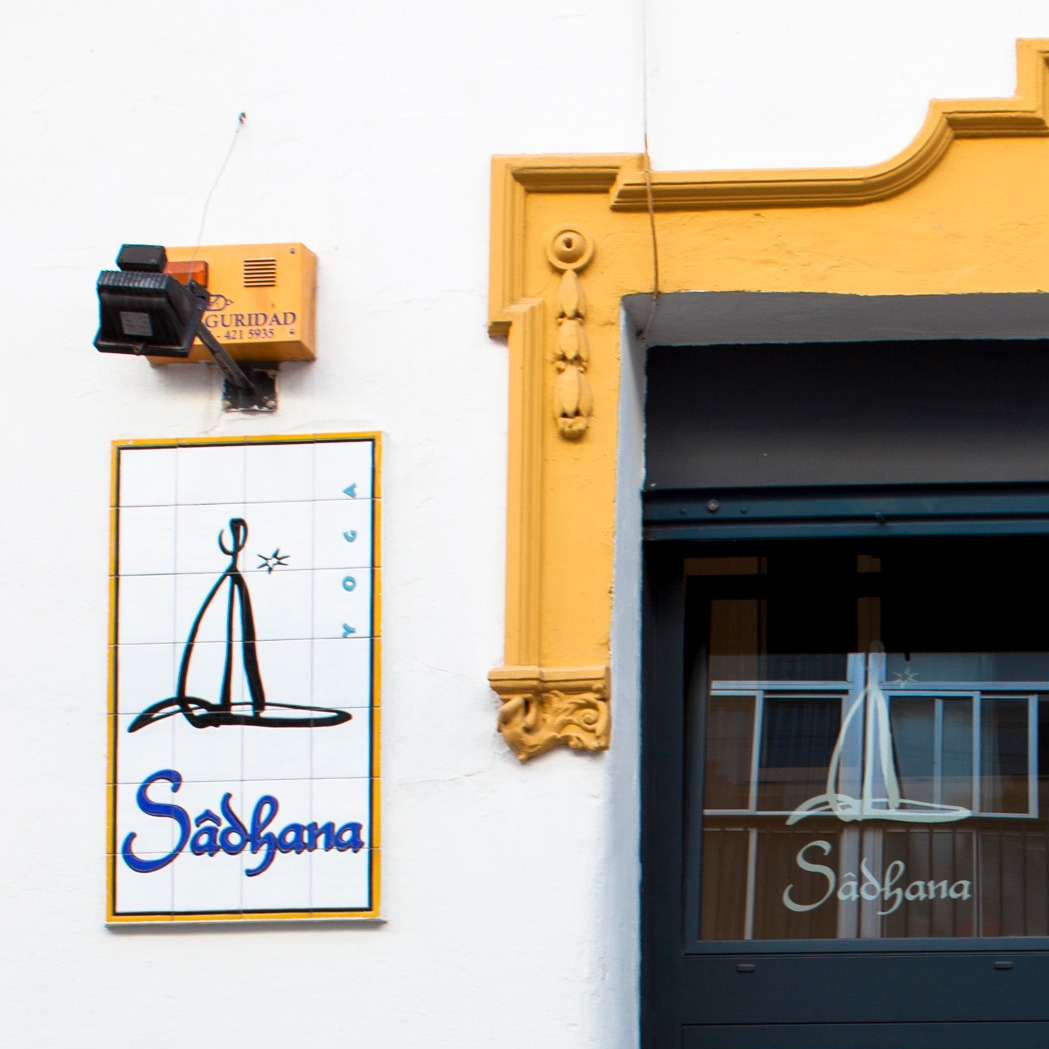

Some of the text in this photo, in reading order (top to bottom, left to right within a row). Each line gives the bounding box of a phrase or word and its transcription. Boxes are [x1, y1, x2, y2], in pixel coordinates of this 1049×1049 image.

[204, 311, 297, 329] GURIDAD
[224, 328, 275, 340] 421 5935
[121, 768, 366, 877] Sâdhana
[782, 839, 972, 915] Sâdhana
